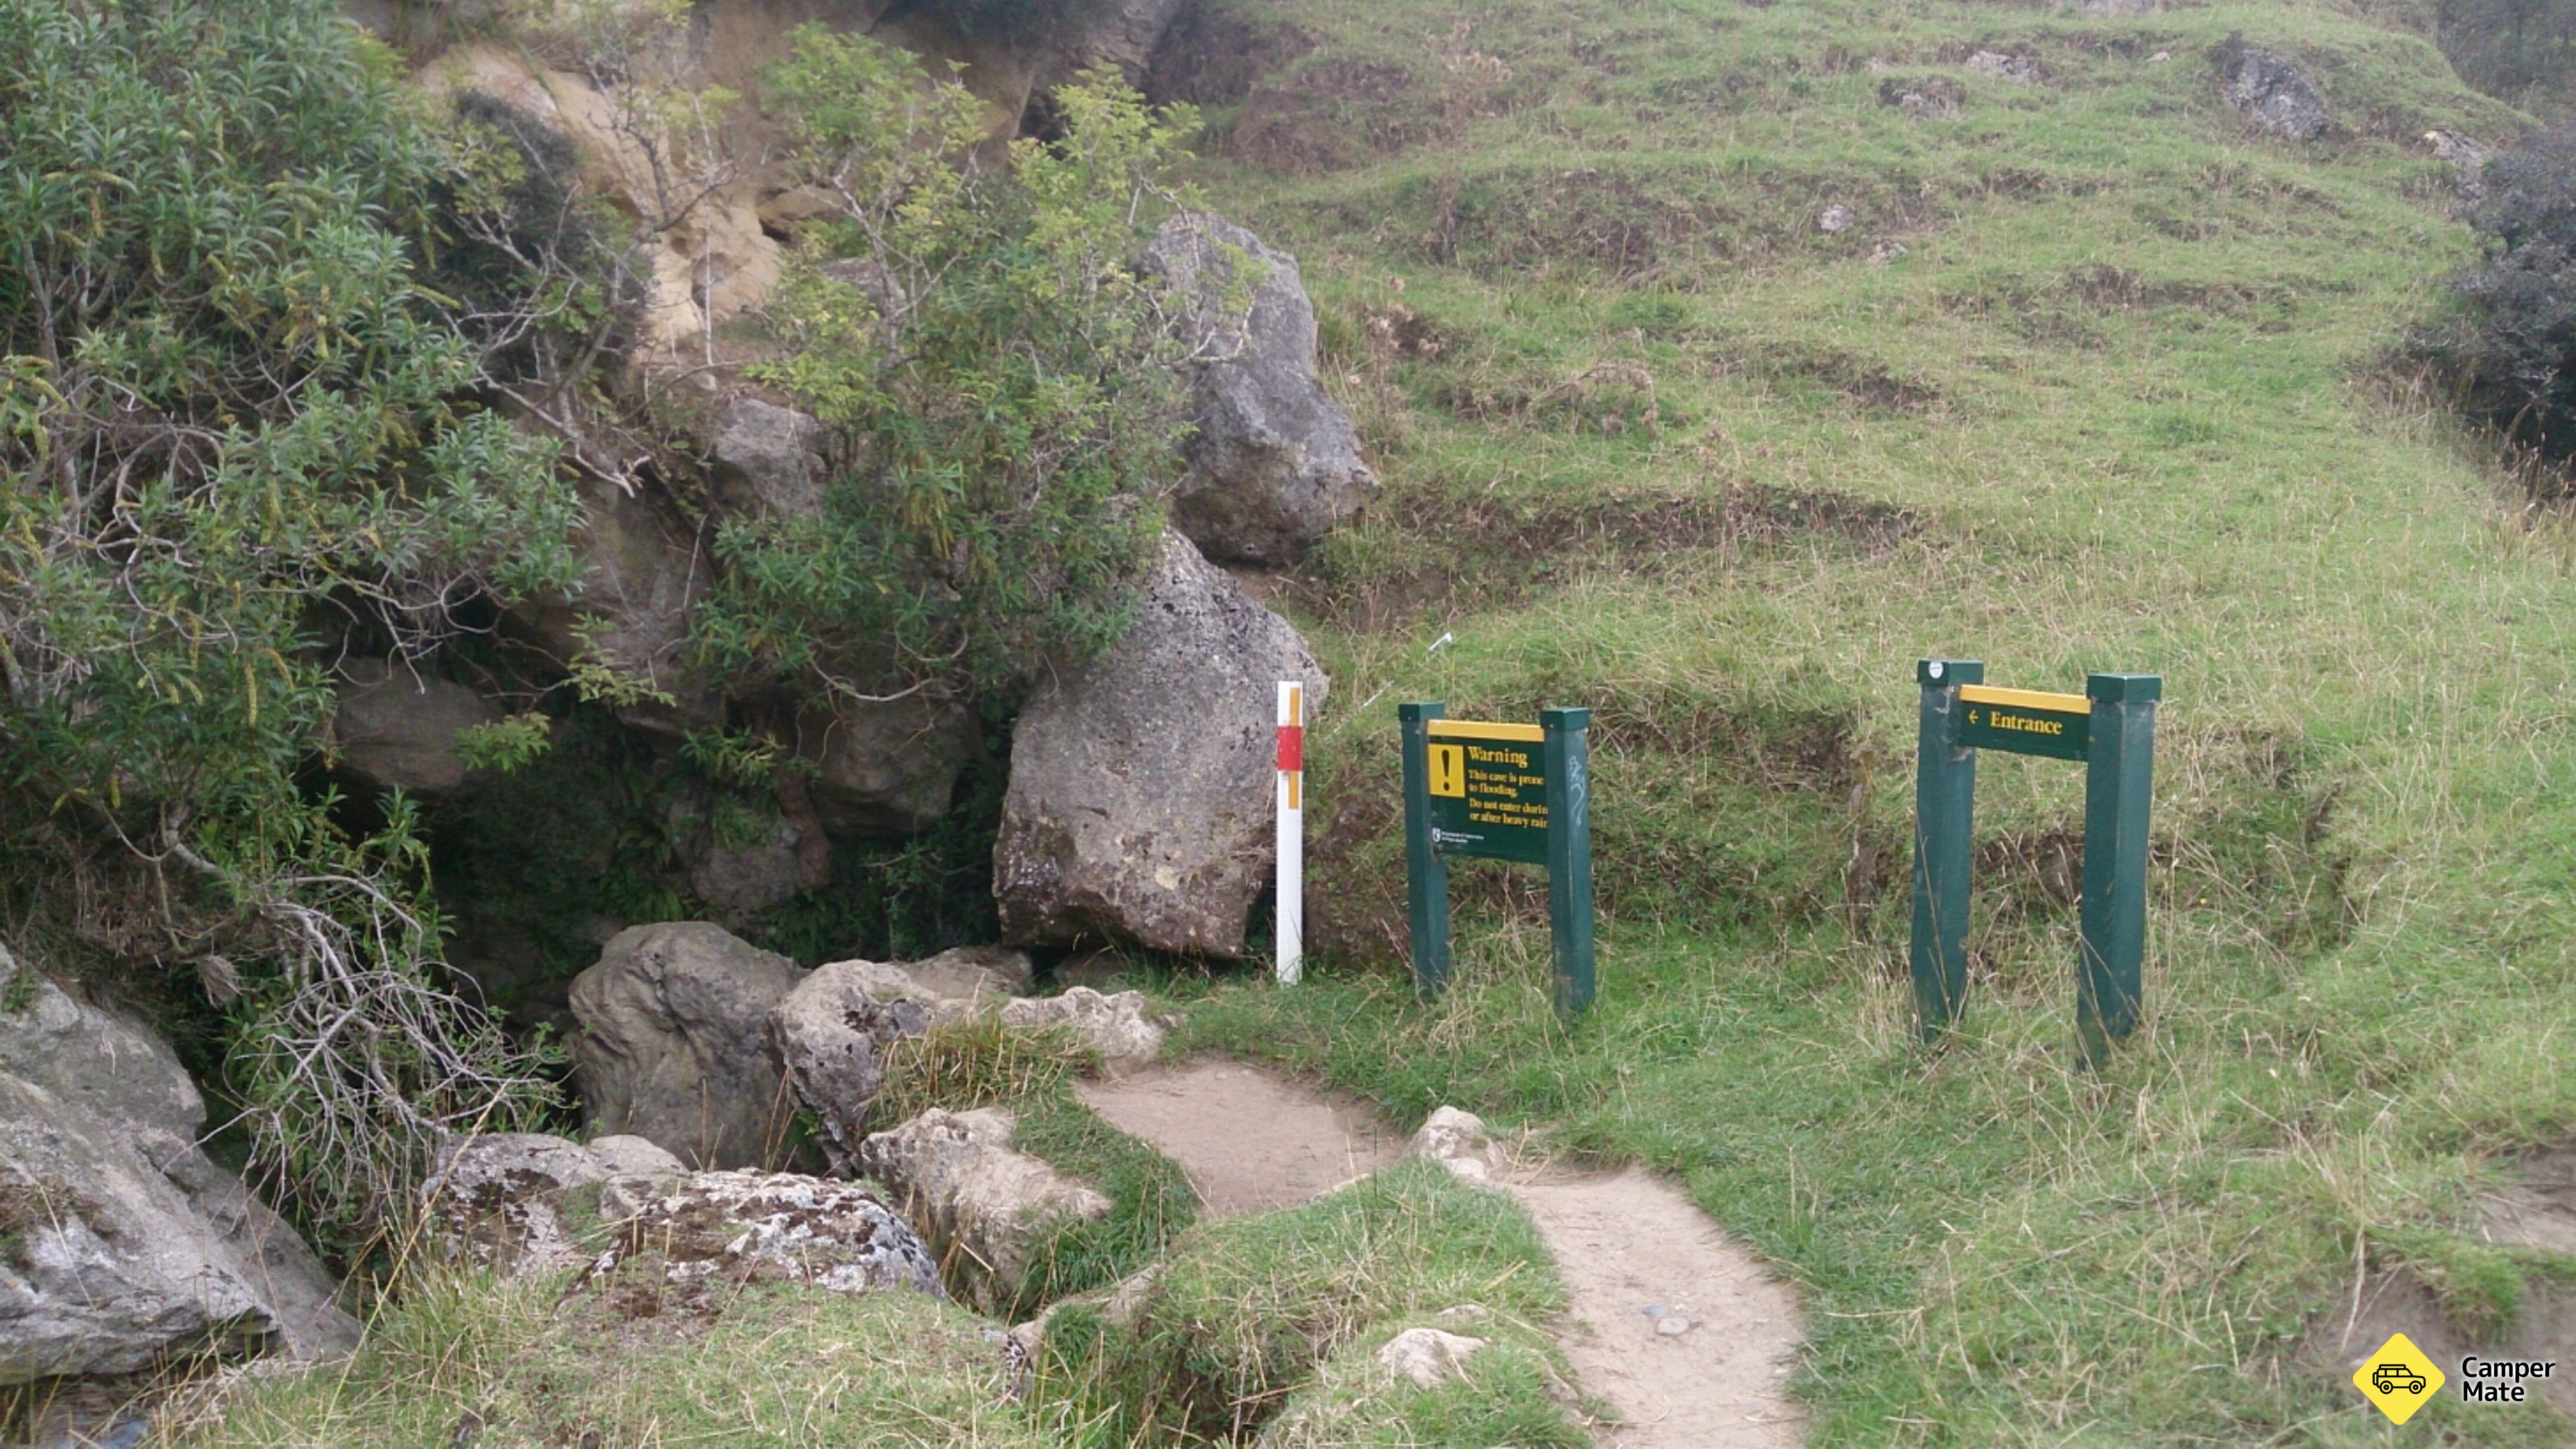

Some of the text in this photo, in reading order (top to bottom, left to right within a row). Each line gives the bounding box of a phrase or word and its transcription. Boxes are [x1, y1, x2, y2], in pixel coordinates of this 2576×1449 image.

[1990, 710, 2062, 735] Entrance
[1468, 746, 1528, 768] Warning
[1468, 769, 1544, 786] This cave is prone
[1468, 783, 1477, 791] to
[1470, 798, 1548, 814] Do not enter durin
[1470, 813, 1479, 821] or
[1481, 811, 1501, 823] after
[1503, 813, 1528, 828] heavy
